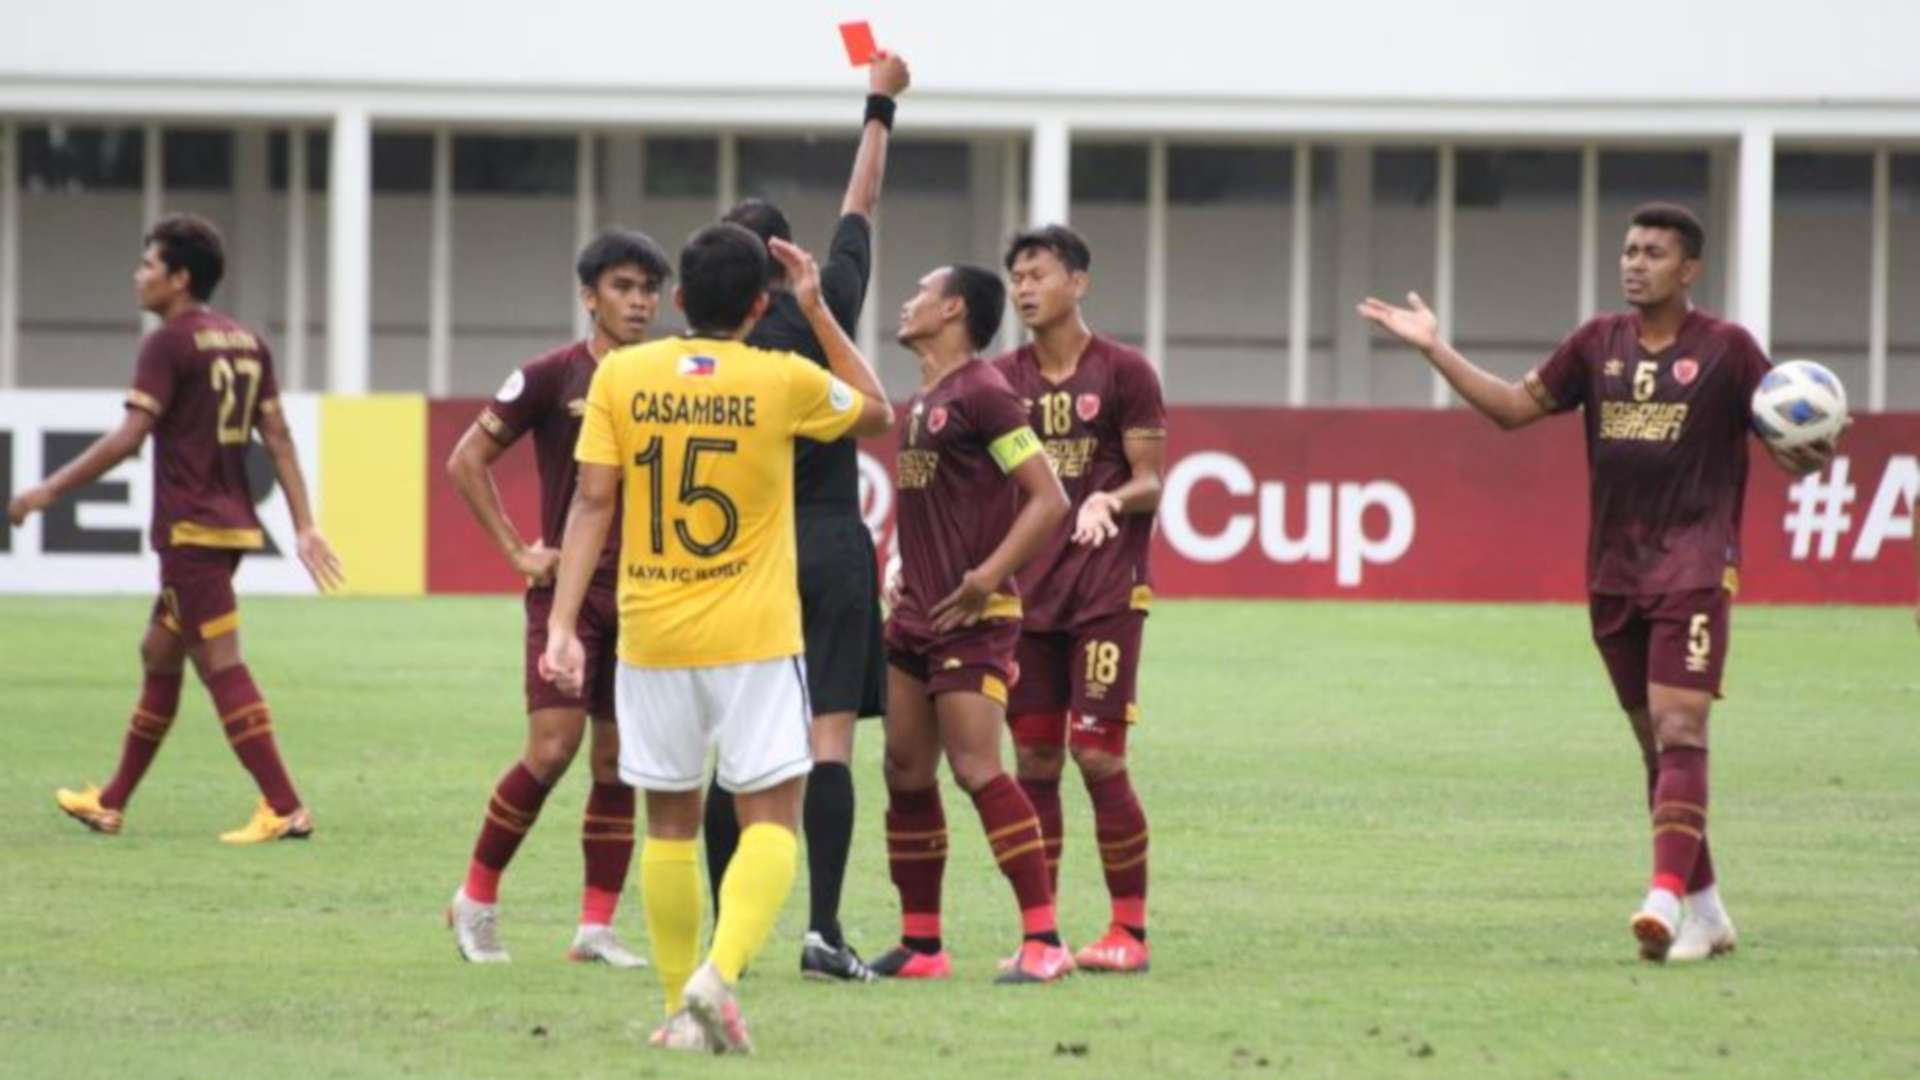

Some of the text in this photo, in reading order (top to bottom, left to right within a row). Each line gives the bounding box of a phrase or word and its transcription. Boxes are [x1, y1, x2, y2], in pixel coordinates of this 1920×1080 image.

[211, 356, 262, 444] 27
[631, 391, 756, 427] CASAMBRE
[1039, 391, 1072, 436] 18
[634, 434, 738, 558] 15
[1687, 613, 1711, 656] 5
[1085, 640, 1120, 685] 18
